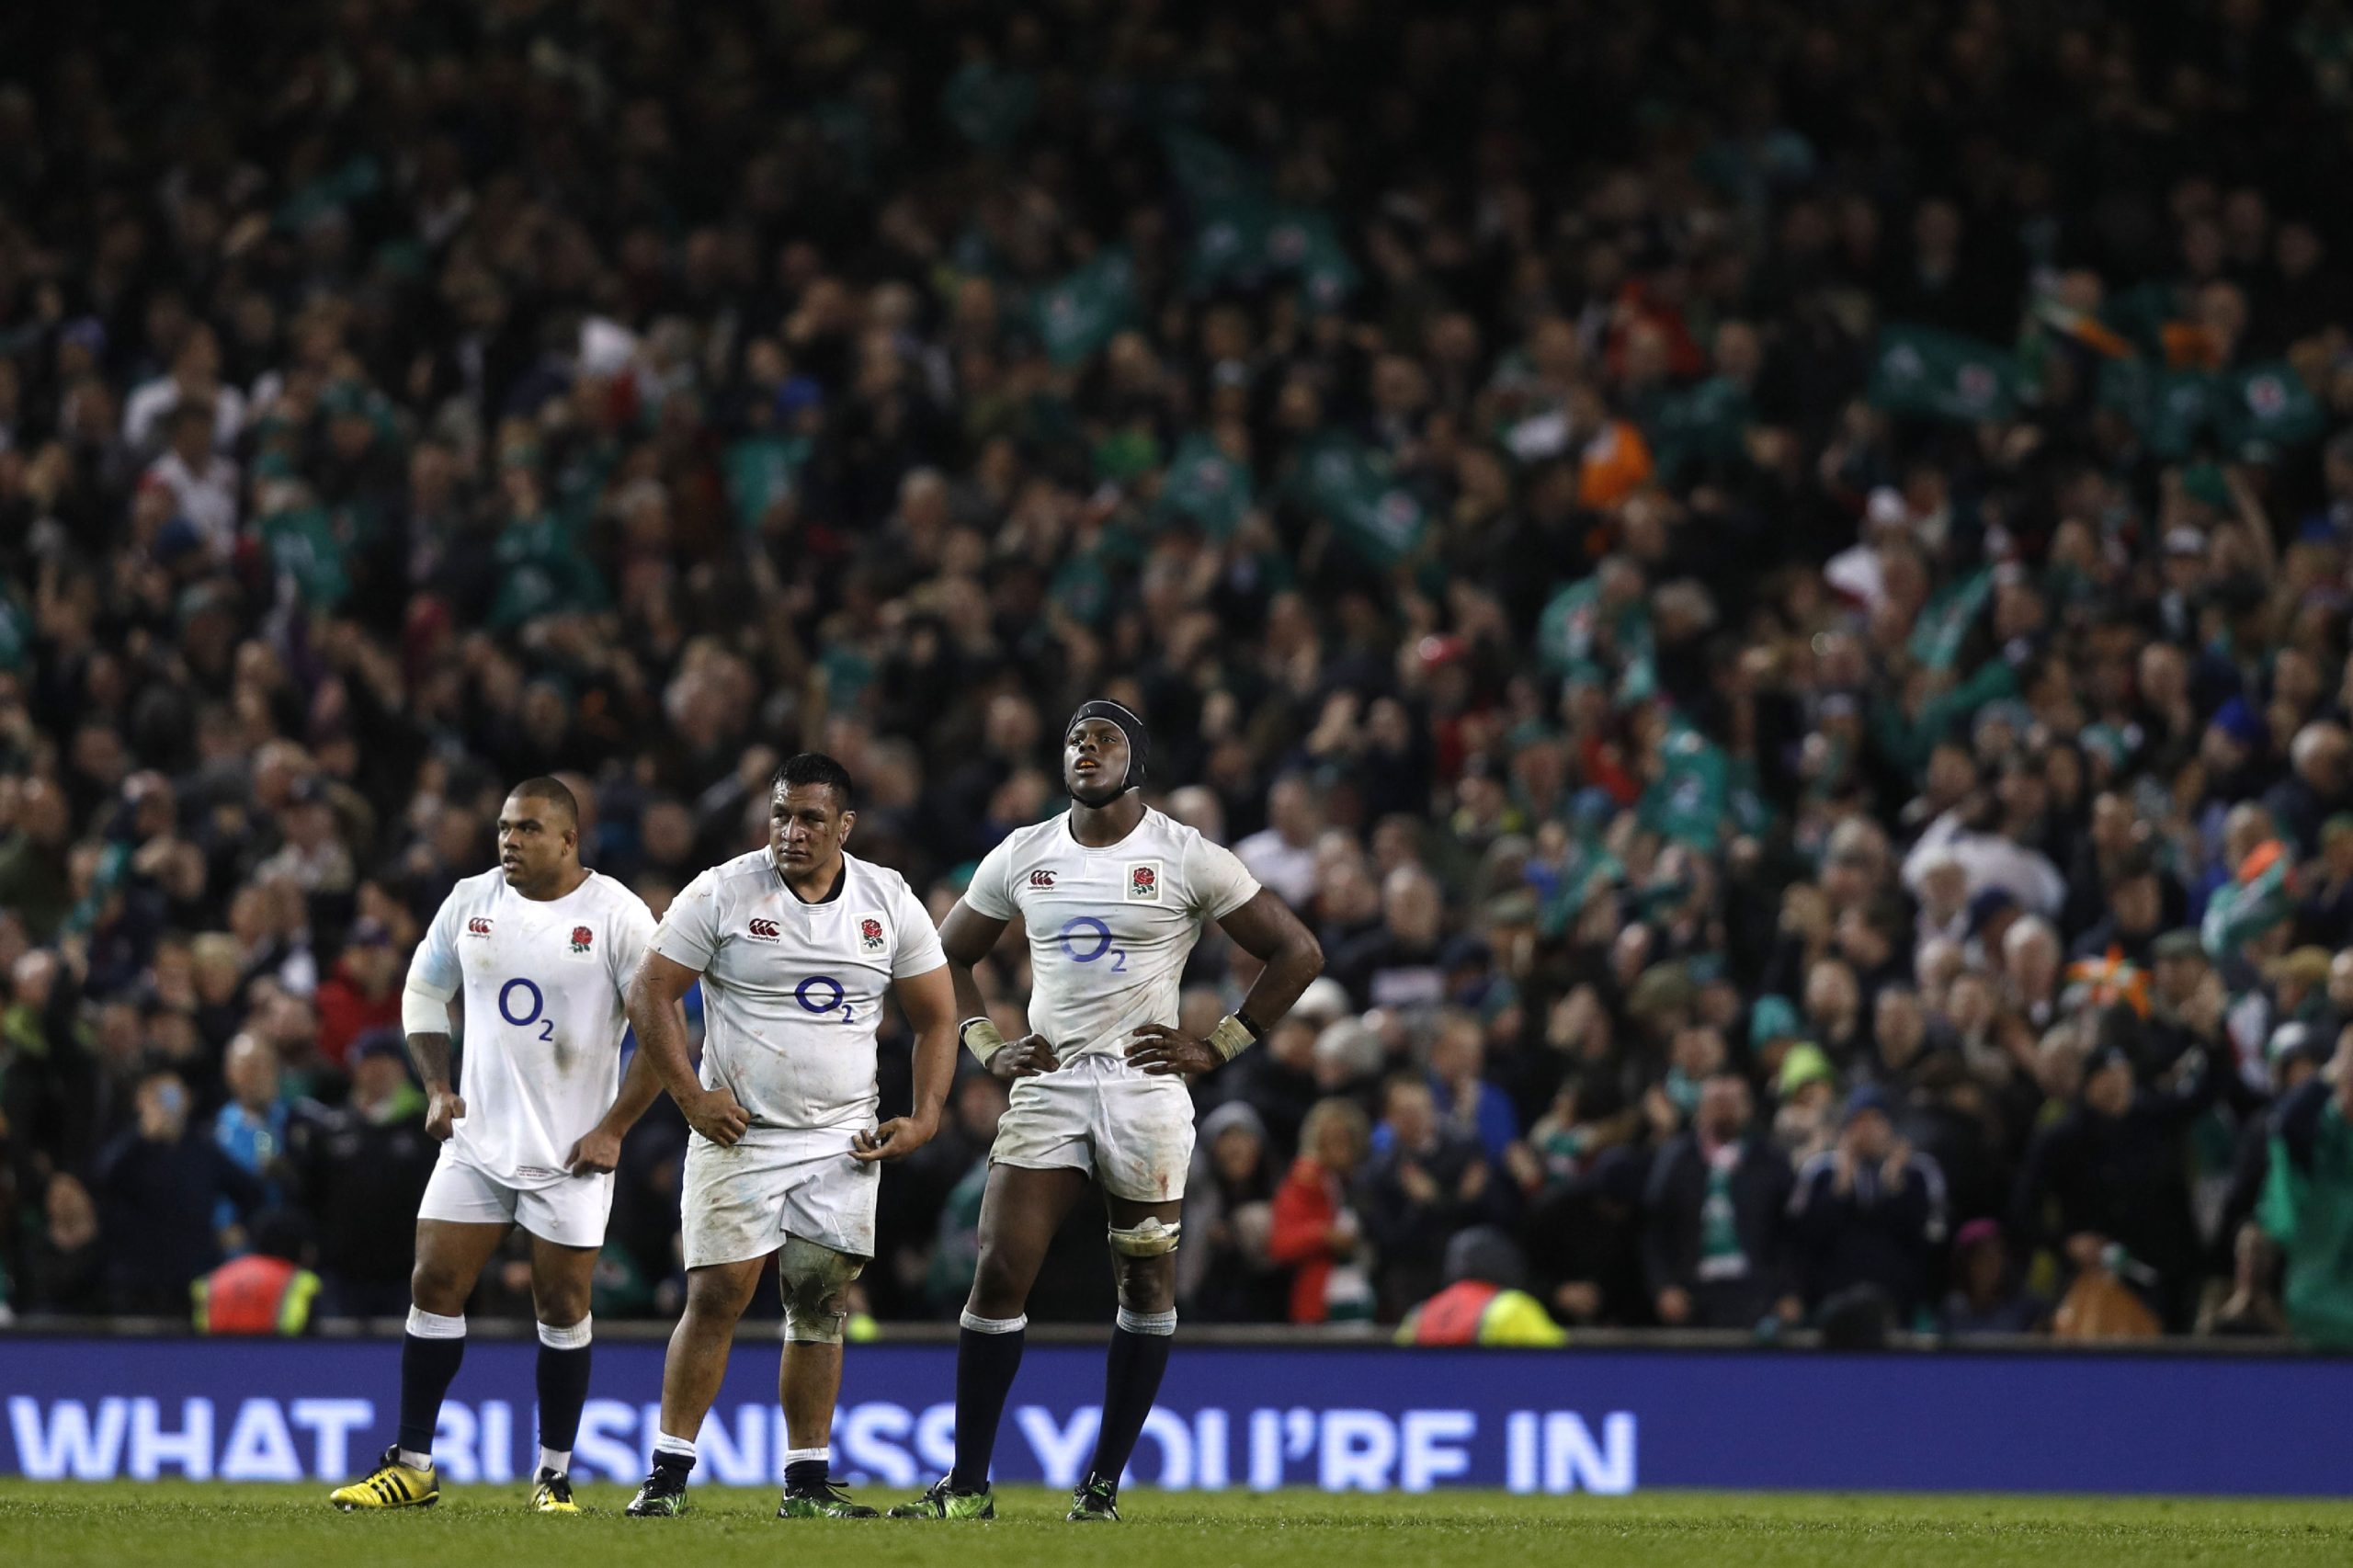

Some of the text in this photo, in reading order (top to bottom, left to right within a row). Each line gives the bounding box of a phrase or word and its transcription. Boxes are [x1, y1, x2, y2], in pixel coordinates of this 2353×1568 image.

[498, 978, 553, 1041] O2
[8, 1396, 375, 1481] WHAT
[1506, 1410, 1638, 1495] IN
